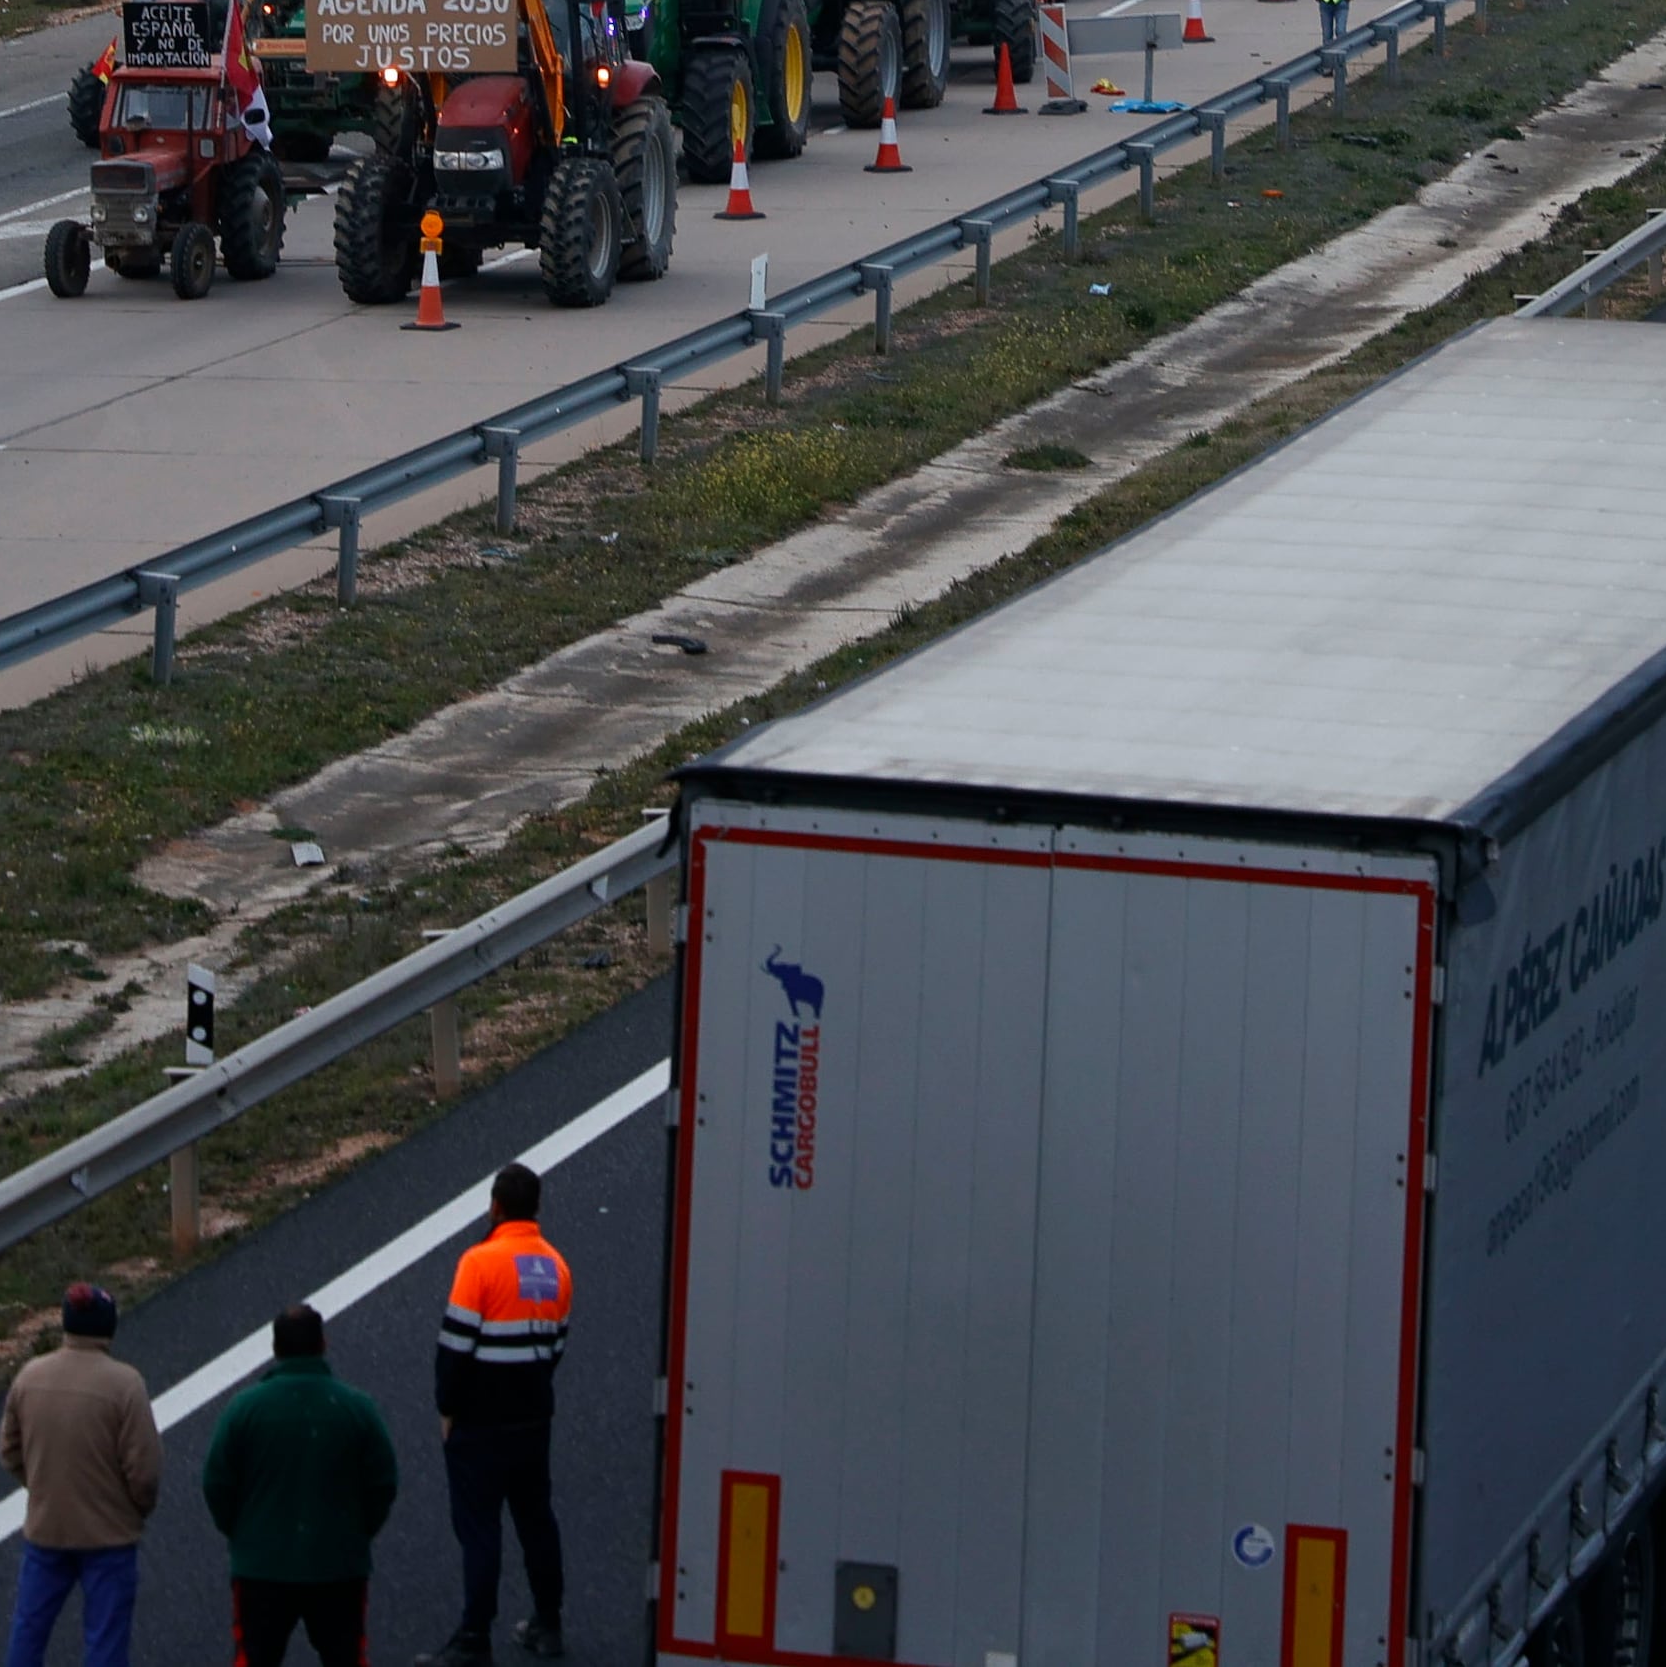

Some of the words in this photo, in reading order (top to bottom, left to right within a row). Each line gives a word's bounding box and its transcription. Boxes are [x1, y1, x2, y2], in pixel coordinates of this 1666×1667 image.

[141, 3, 193, 23] ACEITE
[132, 21, 201, 38] ESPAÑOL
[322, 23, 355, 44] POR
[368, 23, 410, 44] UNOS
[426, 23, 507, 47] PRECIOS
[136, 38, 146, 51] Y
[157, 37, 175, 50] NO
[187, 37, 204, 52] DE
[355, 45, 471, 70] JUSTOS
[769, 1020, 800, 1189] SCHMITZ
[794, 1023, 821, 1192] CARGOBULL
